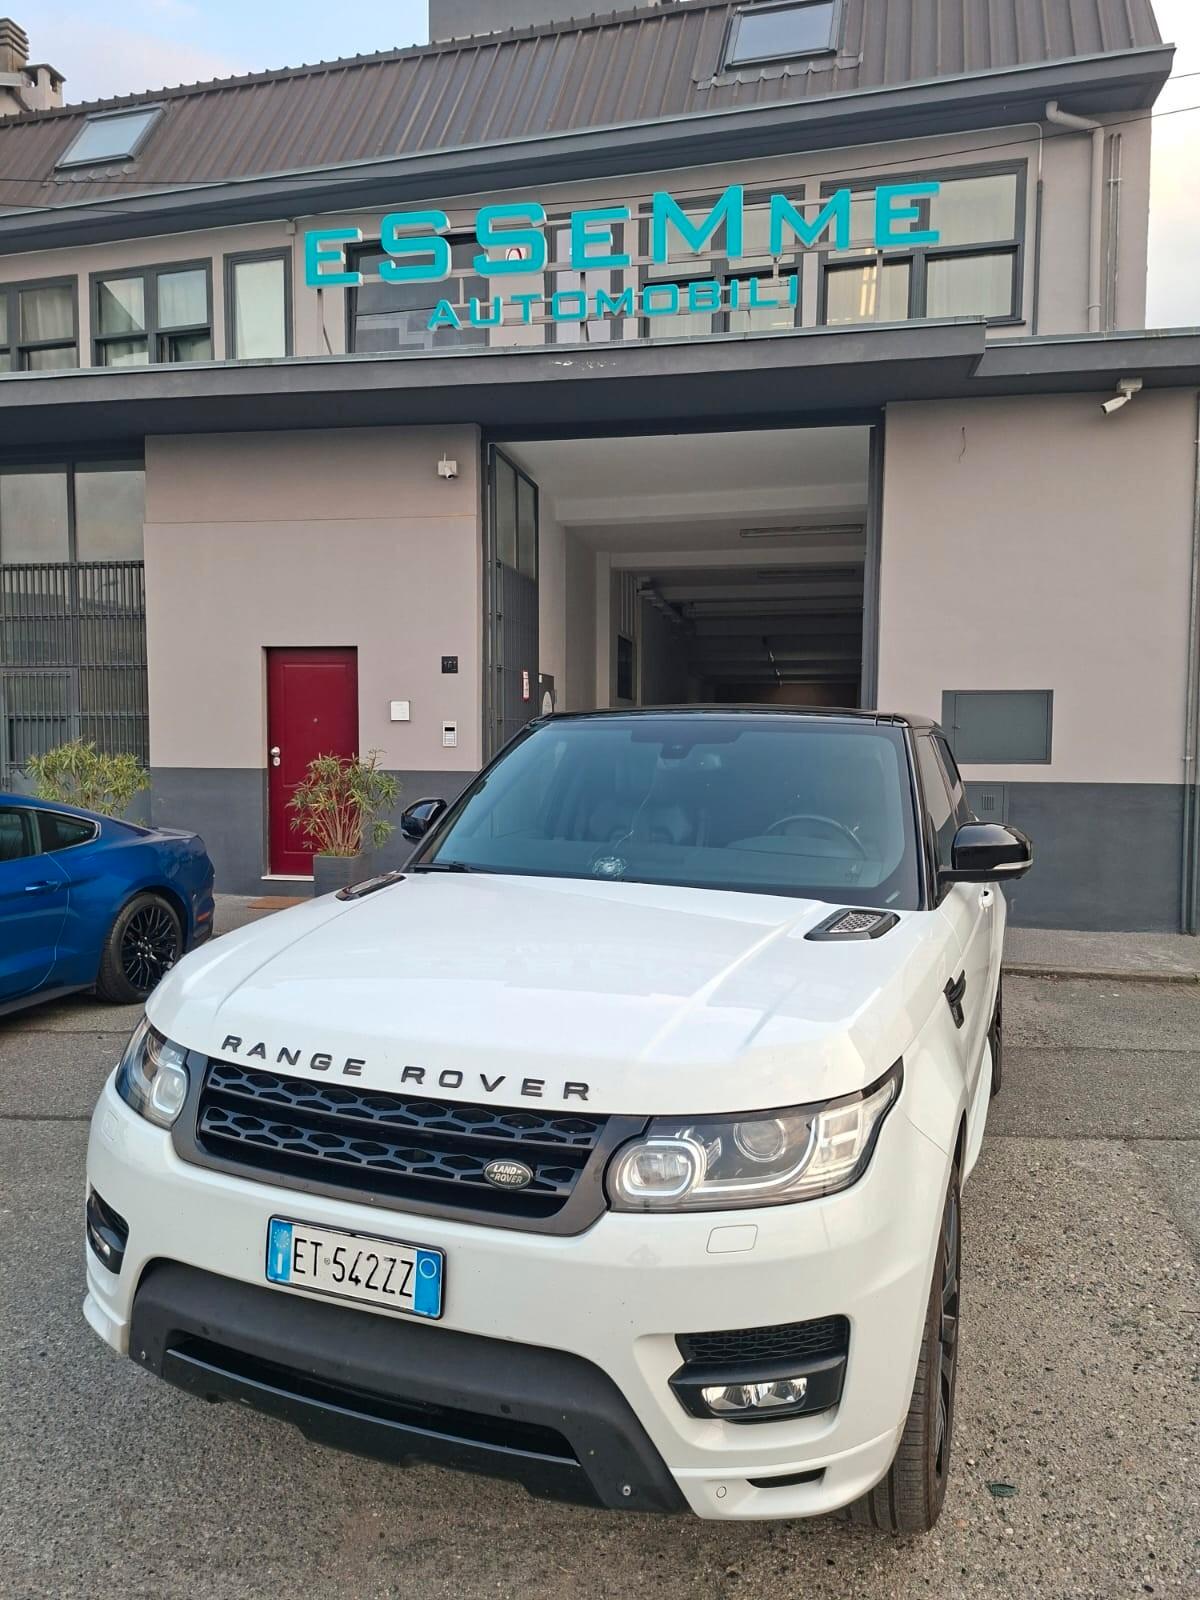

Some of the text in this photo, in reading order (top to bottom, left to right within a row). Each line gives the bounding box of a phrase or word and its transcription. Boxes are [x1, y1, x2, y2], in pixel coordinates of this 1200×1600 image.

[305, 182, 941, 288] ESSEMME
[427, 274, 799, 331] AUTOMOBILI
[221, 1034, 590, 1101] RANGE ROVER
